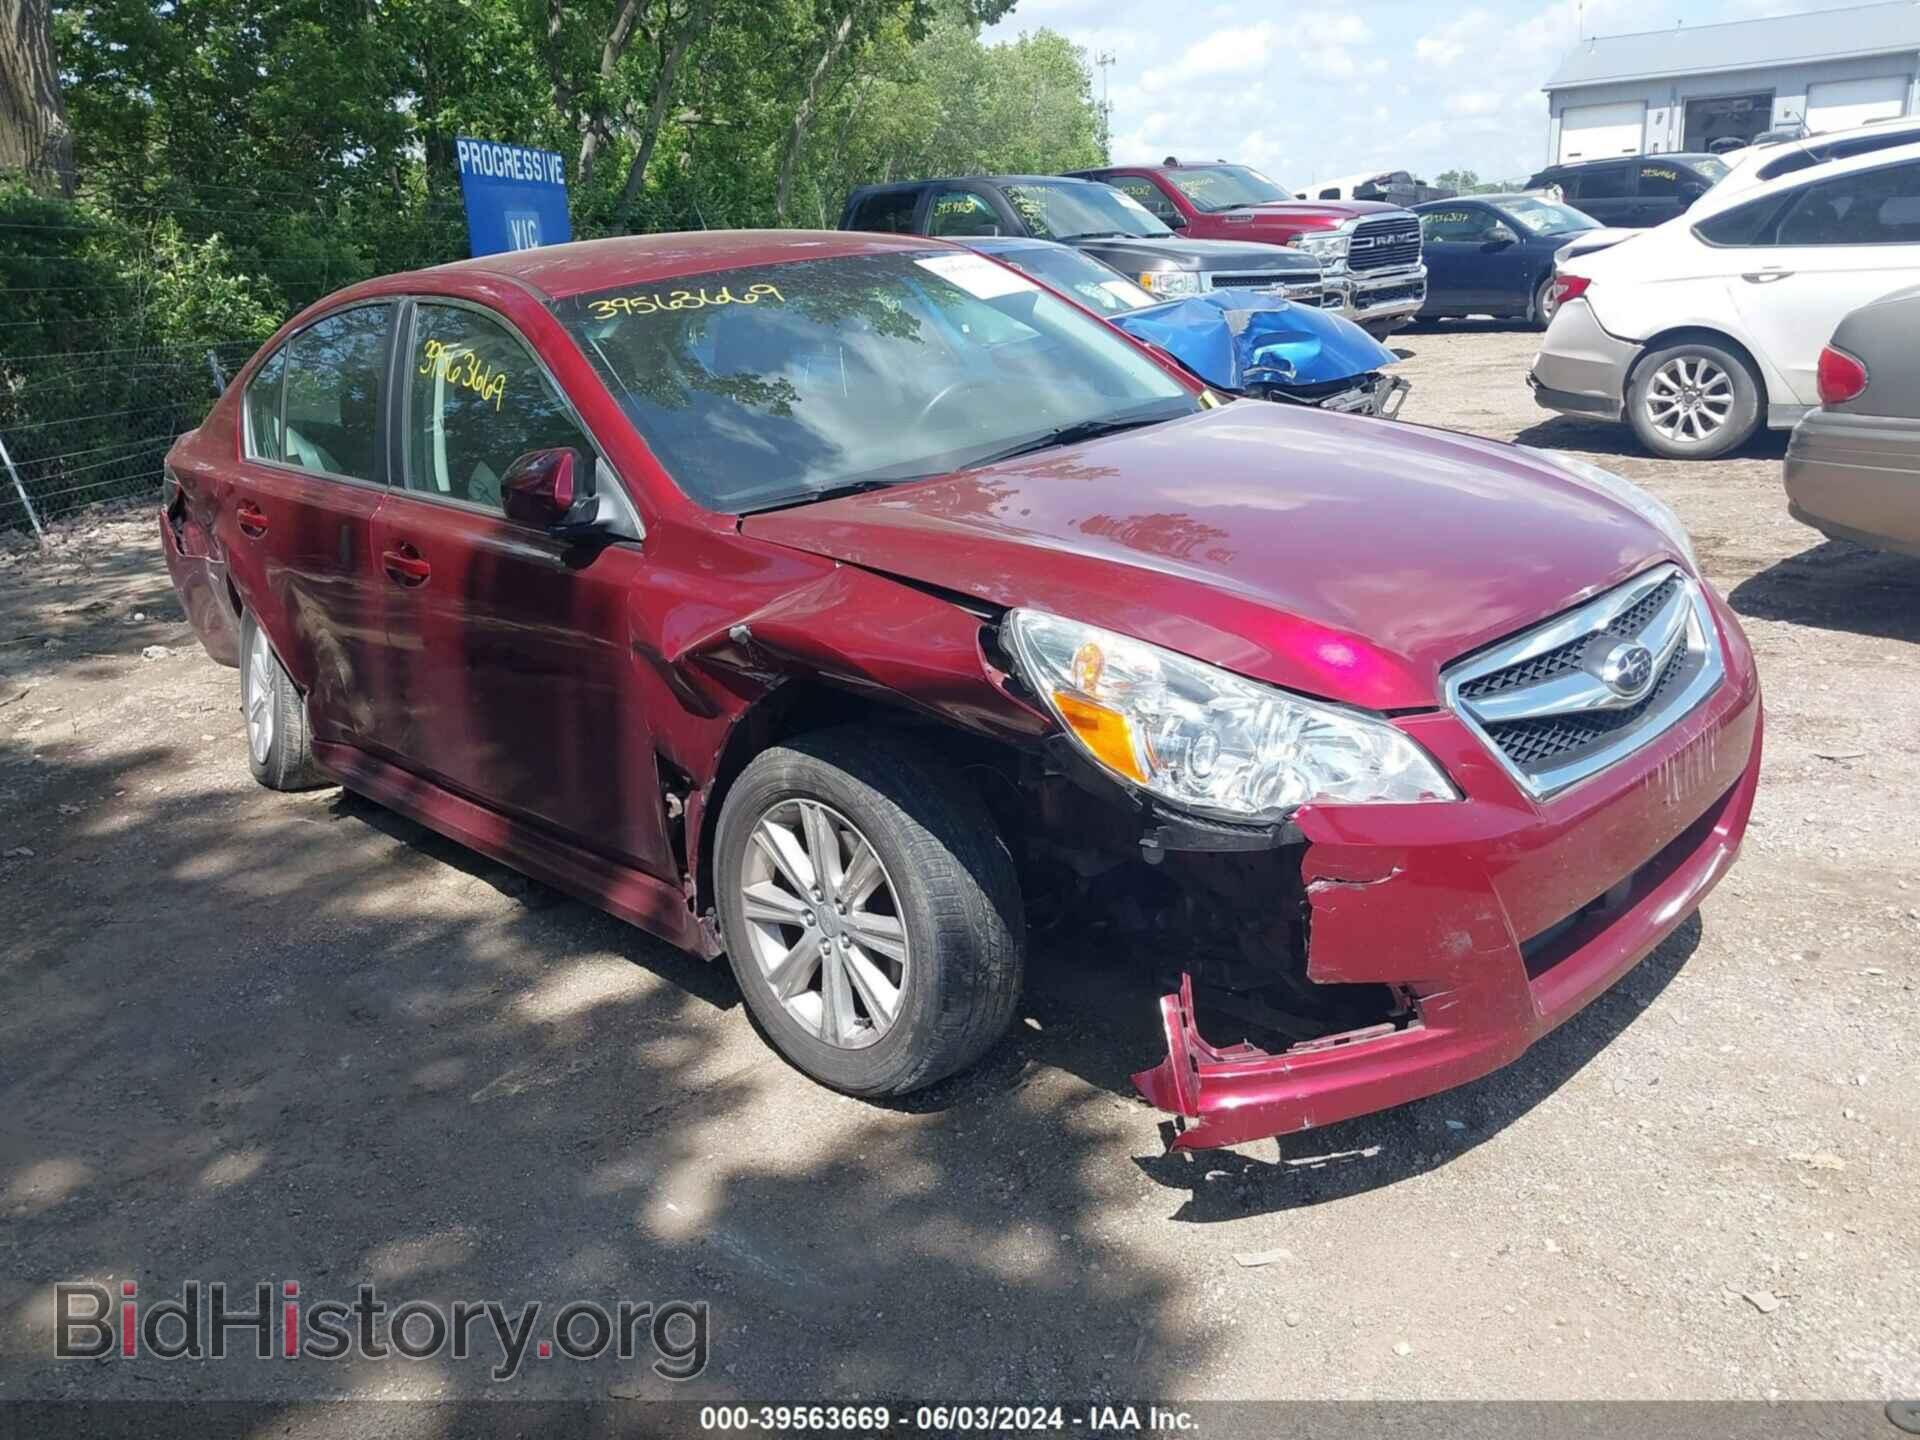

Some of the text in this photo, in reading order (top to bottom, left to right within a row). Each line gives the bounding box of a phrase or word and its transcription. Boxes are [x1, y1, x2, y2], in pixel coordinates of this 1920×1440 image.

[457, 140, 565, 185] PROGRESSIVE
[1375, 232, 1406, 246] RAM
[588, 284, 785, 320] 39563669
